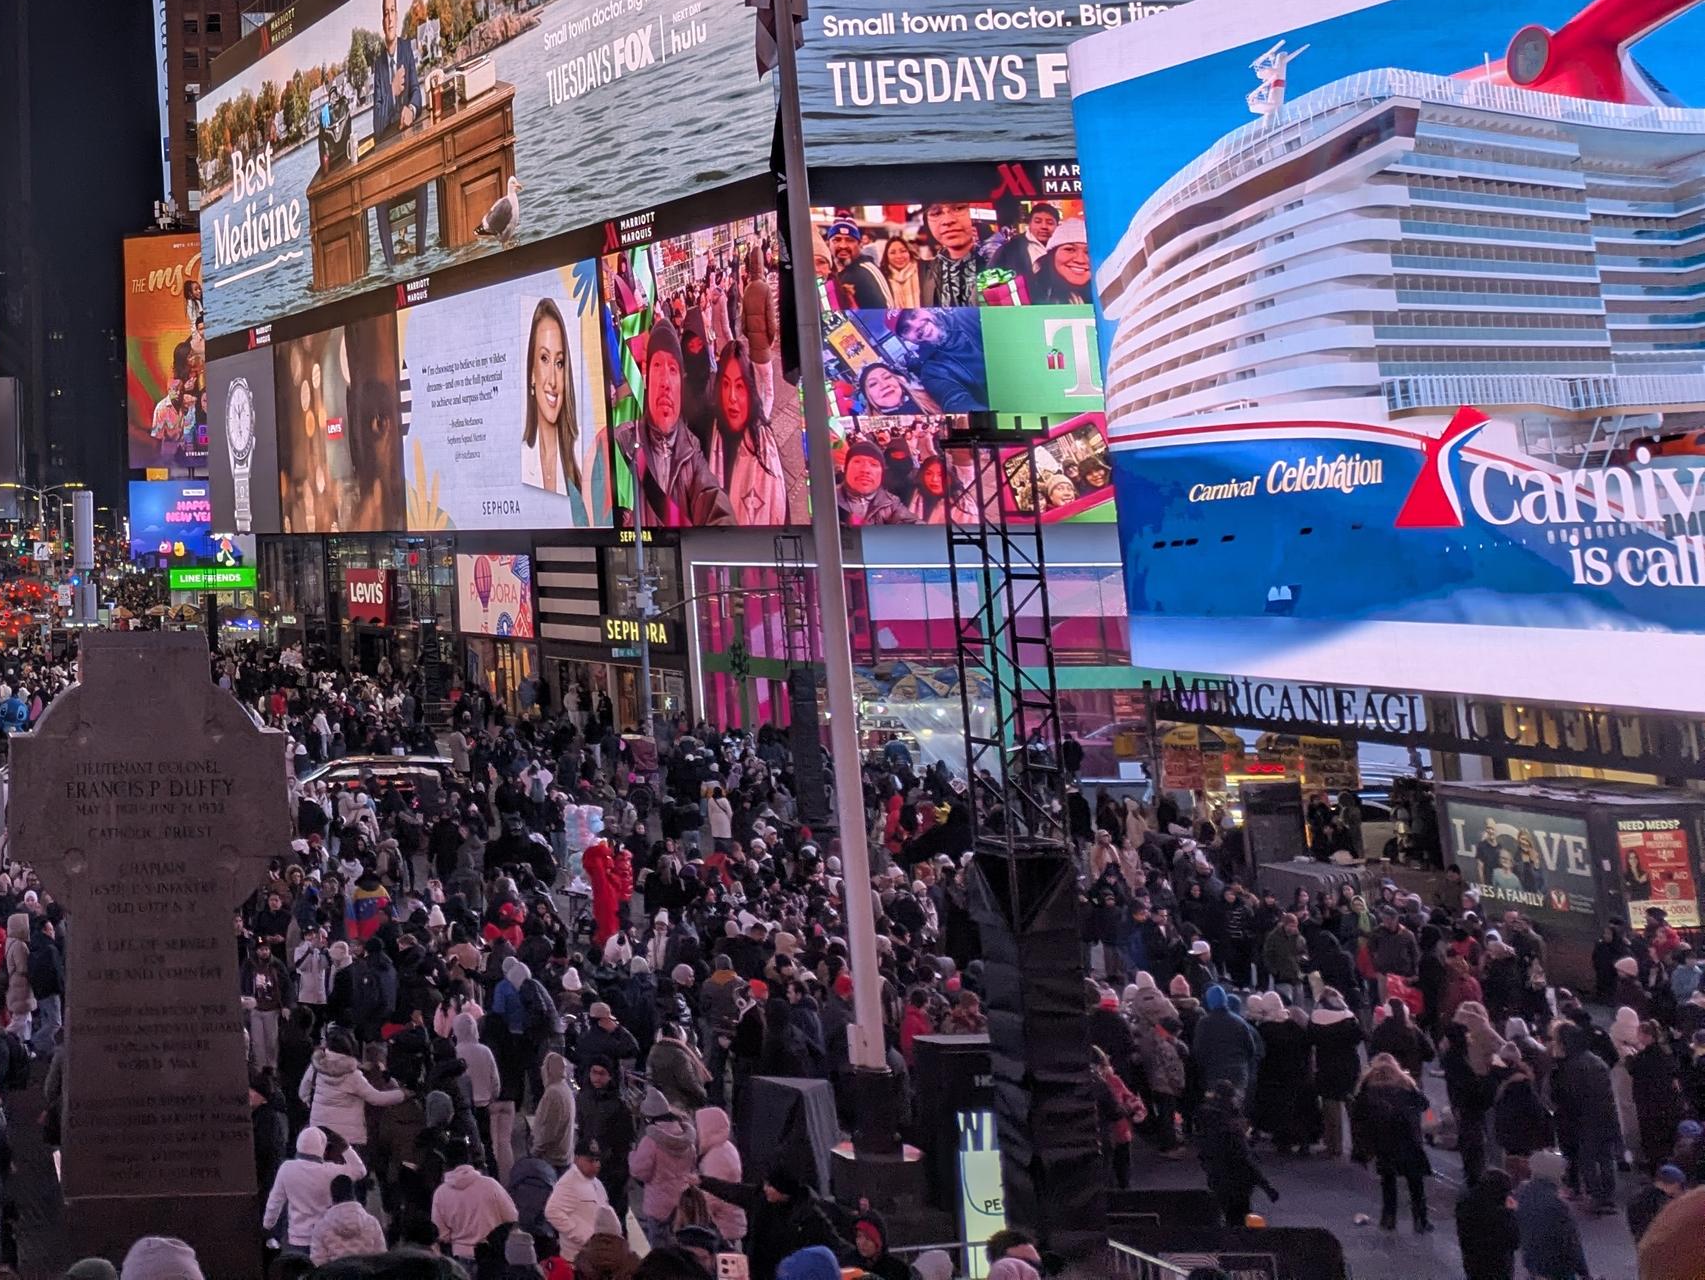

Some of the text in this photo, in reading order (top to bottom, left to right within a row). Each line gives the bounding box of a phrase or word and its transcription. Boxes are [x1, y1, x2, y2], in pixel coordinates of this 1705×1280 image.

[672, 1, 702, 25] NEXT DAY
[823, 3, 1122, 37] Small town doctor. Big
[543, 24, 568, 52] Small
[568, 18, 590, 44] town
[592, 0, 625, 30] doctor.
[671, 20, 707, 56] hulu
[546, 24, 656, 108] TUESDAYS FOX
[827, 53, 1028, 108] TUESDAYS
[231, 141, 274, 204] Best
[620, 212, 654, 230] MARRIOTT
[214, 194, 302, 270] Medicine
[621, 227, 652, 244] MARQUIS
[132, 278, 146, 293] THE
[407, 278, 430, 291] MARRIOTT
[407, 290, 428, 303] MARQUIS
[488, 353, 507, 364] wildest
[472, 373, 481, 385] full
[481, 370, 503, 386] potential
[436, 394, 479, 408] achieve and surpass
[1189, 453, 1383, 503] Carnival Celebration
[1470, 445, 1705, 526] Carniv
[482, 500, 521, 516] SEPHORA
[165, 512, 192, 523] NEW
[1569, 533, 1612, 587] is
[179, 574, 242, 583] LINE FRIENDS
[1159, 670, 1327, 724] AMERICAN
[76, 759, 222, 776] LIEUTENANT COLONEL
[65, 778, 235, 799] FRANCIS P DUFFY
[88, 825, 213, 840] CATHOLIC PRIEST
[1618, 819, 1680, 831] NEED MEDS?
[1497, 888, 1545, 908] A FAMILY
[984, 1198, 1001, 1213] PE
